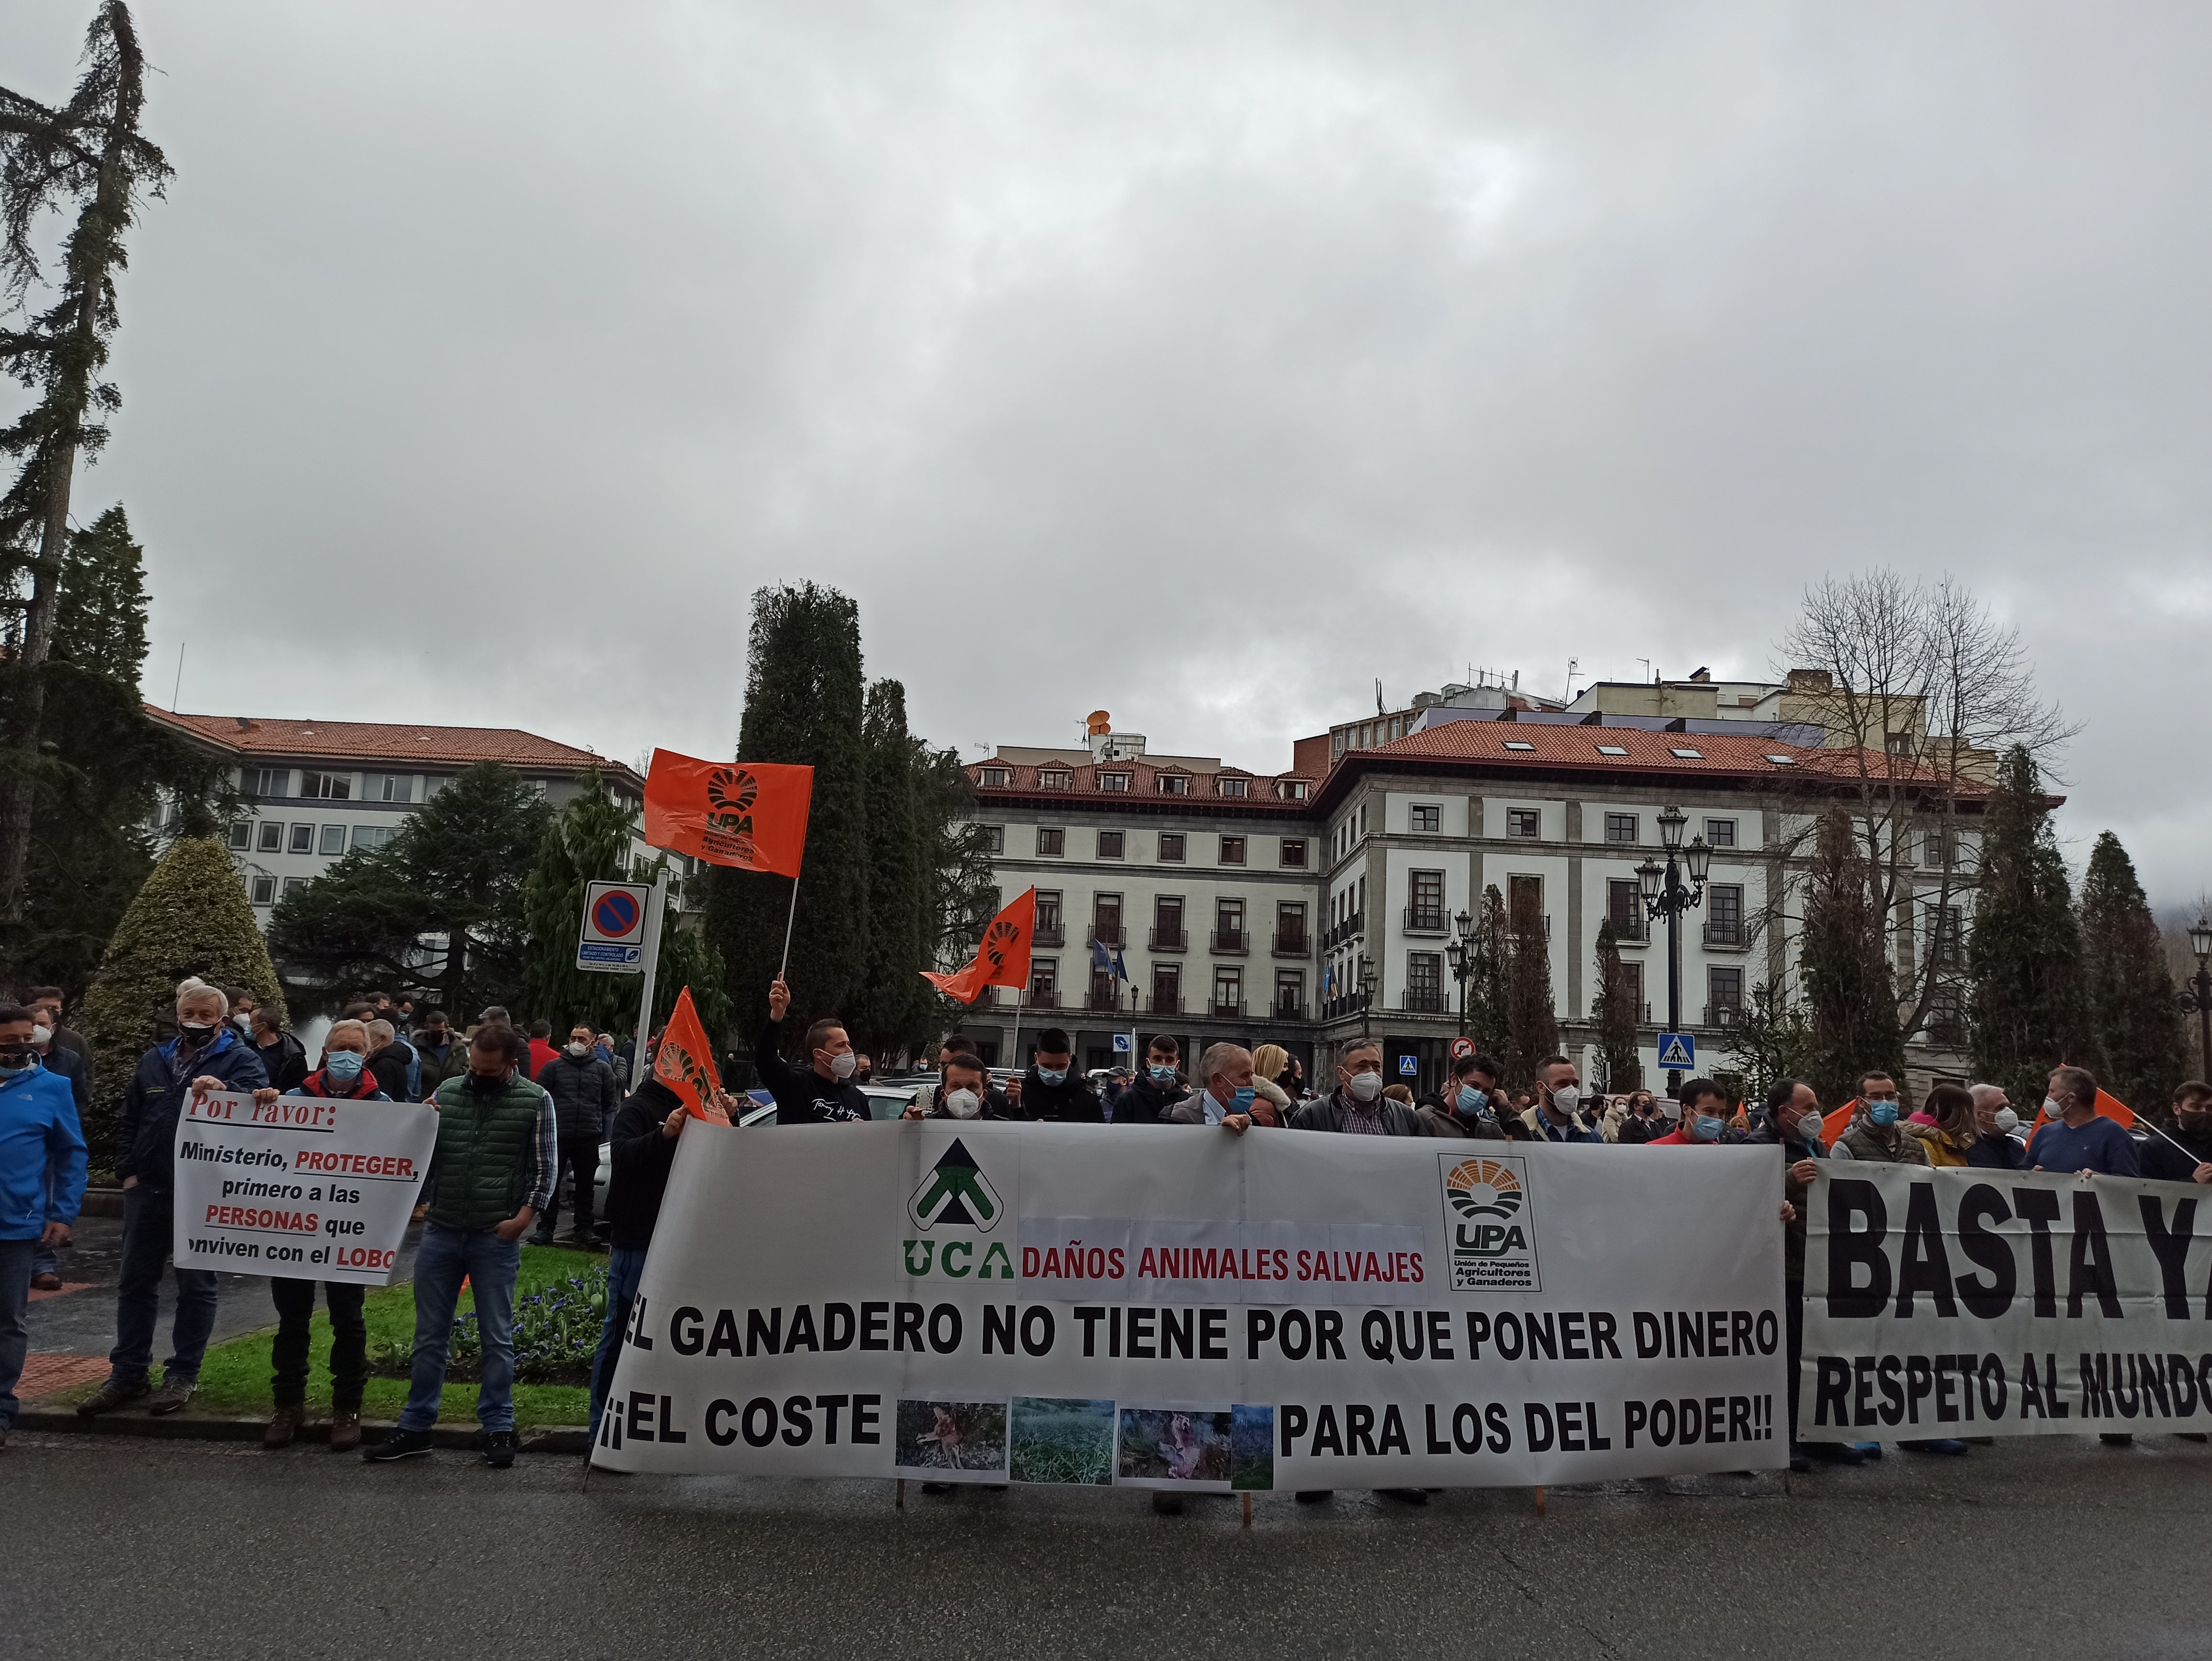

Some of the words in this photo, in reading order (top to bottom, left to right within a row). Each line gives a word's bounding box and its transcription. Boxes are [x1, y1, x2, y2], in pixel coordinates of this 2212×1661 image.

[707, 812, 753, 835] UPA
[703, 836, 754, 853] Agricultores
[708, 845, 753, 862] Ganaderos
[189, 1093, 238, 1119] Por
[179, 1141, 288, 1172] Ministerio,
[295, 1151, 419, 1181] PROTEGER,
[222, 1178, 302, 1199] primero
[309, 1188, 321, 1201] a
[329, 1185, 360, 1204] las
[205, 1205, 318, 1232] PERSONAS
[325, 1218, 365, 1238] que
[266, 1246, 303, 1262] con
[310, 1246, 330, 1264] el
[1454, 1224, 1527, 1257] UPA
[1826, 1178, 2124, 1319] BASTA
[2137, 1194, 2212, 1321] Y
[903, 1240, 1015, 1280] UCA
[1022, 1240, 1125, 1279] DAÑOS
[1138, 1247, 1288, 1281] ANIMALES
[1296, 1249, 1424, 1283] SALVAJES
[1456, 1267, 1531, 1277] Agricultores
[1457, 1278, 1464, 1287] y
[1467, 1277, 1532, 1286] Ganaderos
[669, 1301, 962, 1358] GANADERO
[982, 1304, 1055, 1357] NO
[1073, 1307, 1228, 1360] TIENE
[1247, 1308, 1347, 1361] POR
[1360, 1309, 1455, 1365] QUE
[1466, 1311, 1623, 1361] PONER
[1632, 1309, 1779, 1359] DINERO
[1814, 1352, 2008, 1427] RESPETO
[2020, 1352, 2069, 1419] AL
[705, 1394, 881, 1448] COSTE
[1280, 1403, 1411, 1457] PARA
[1425, 1402, 1512, 1454] LOS
[1523, 1401, 1611, 1453] DEL
[1624, 1394, 1772, 1450] PODER!!
